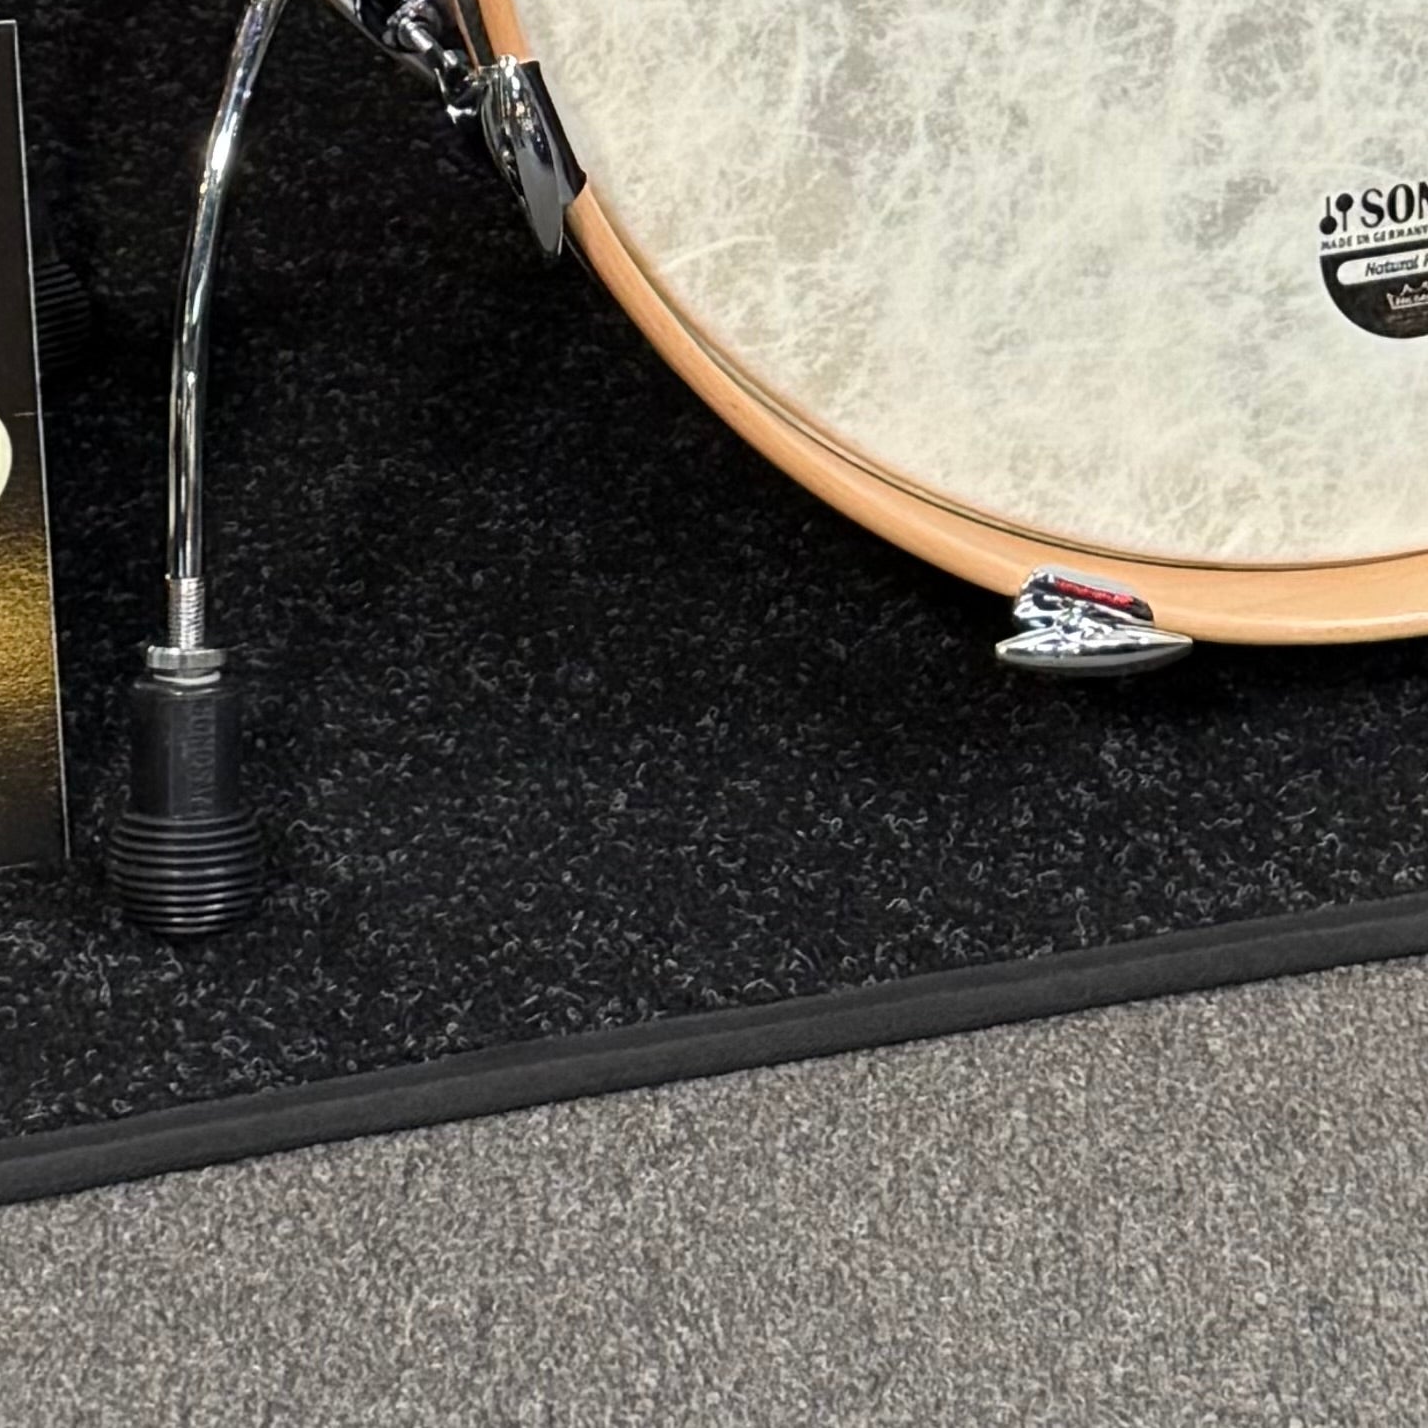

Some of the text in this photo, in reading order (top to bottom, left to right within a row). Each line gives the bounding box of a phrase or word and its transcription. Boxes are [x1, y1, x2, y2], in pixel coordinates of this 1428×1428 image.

[1320, 235, 1353, 251] MADE
[1372, 224, 1428, 242] GERMANY
[1364, 254, 1420, 278] Natural
